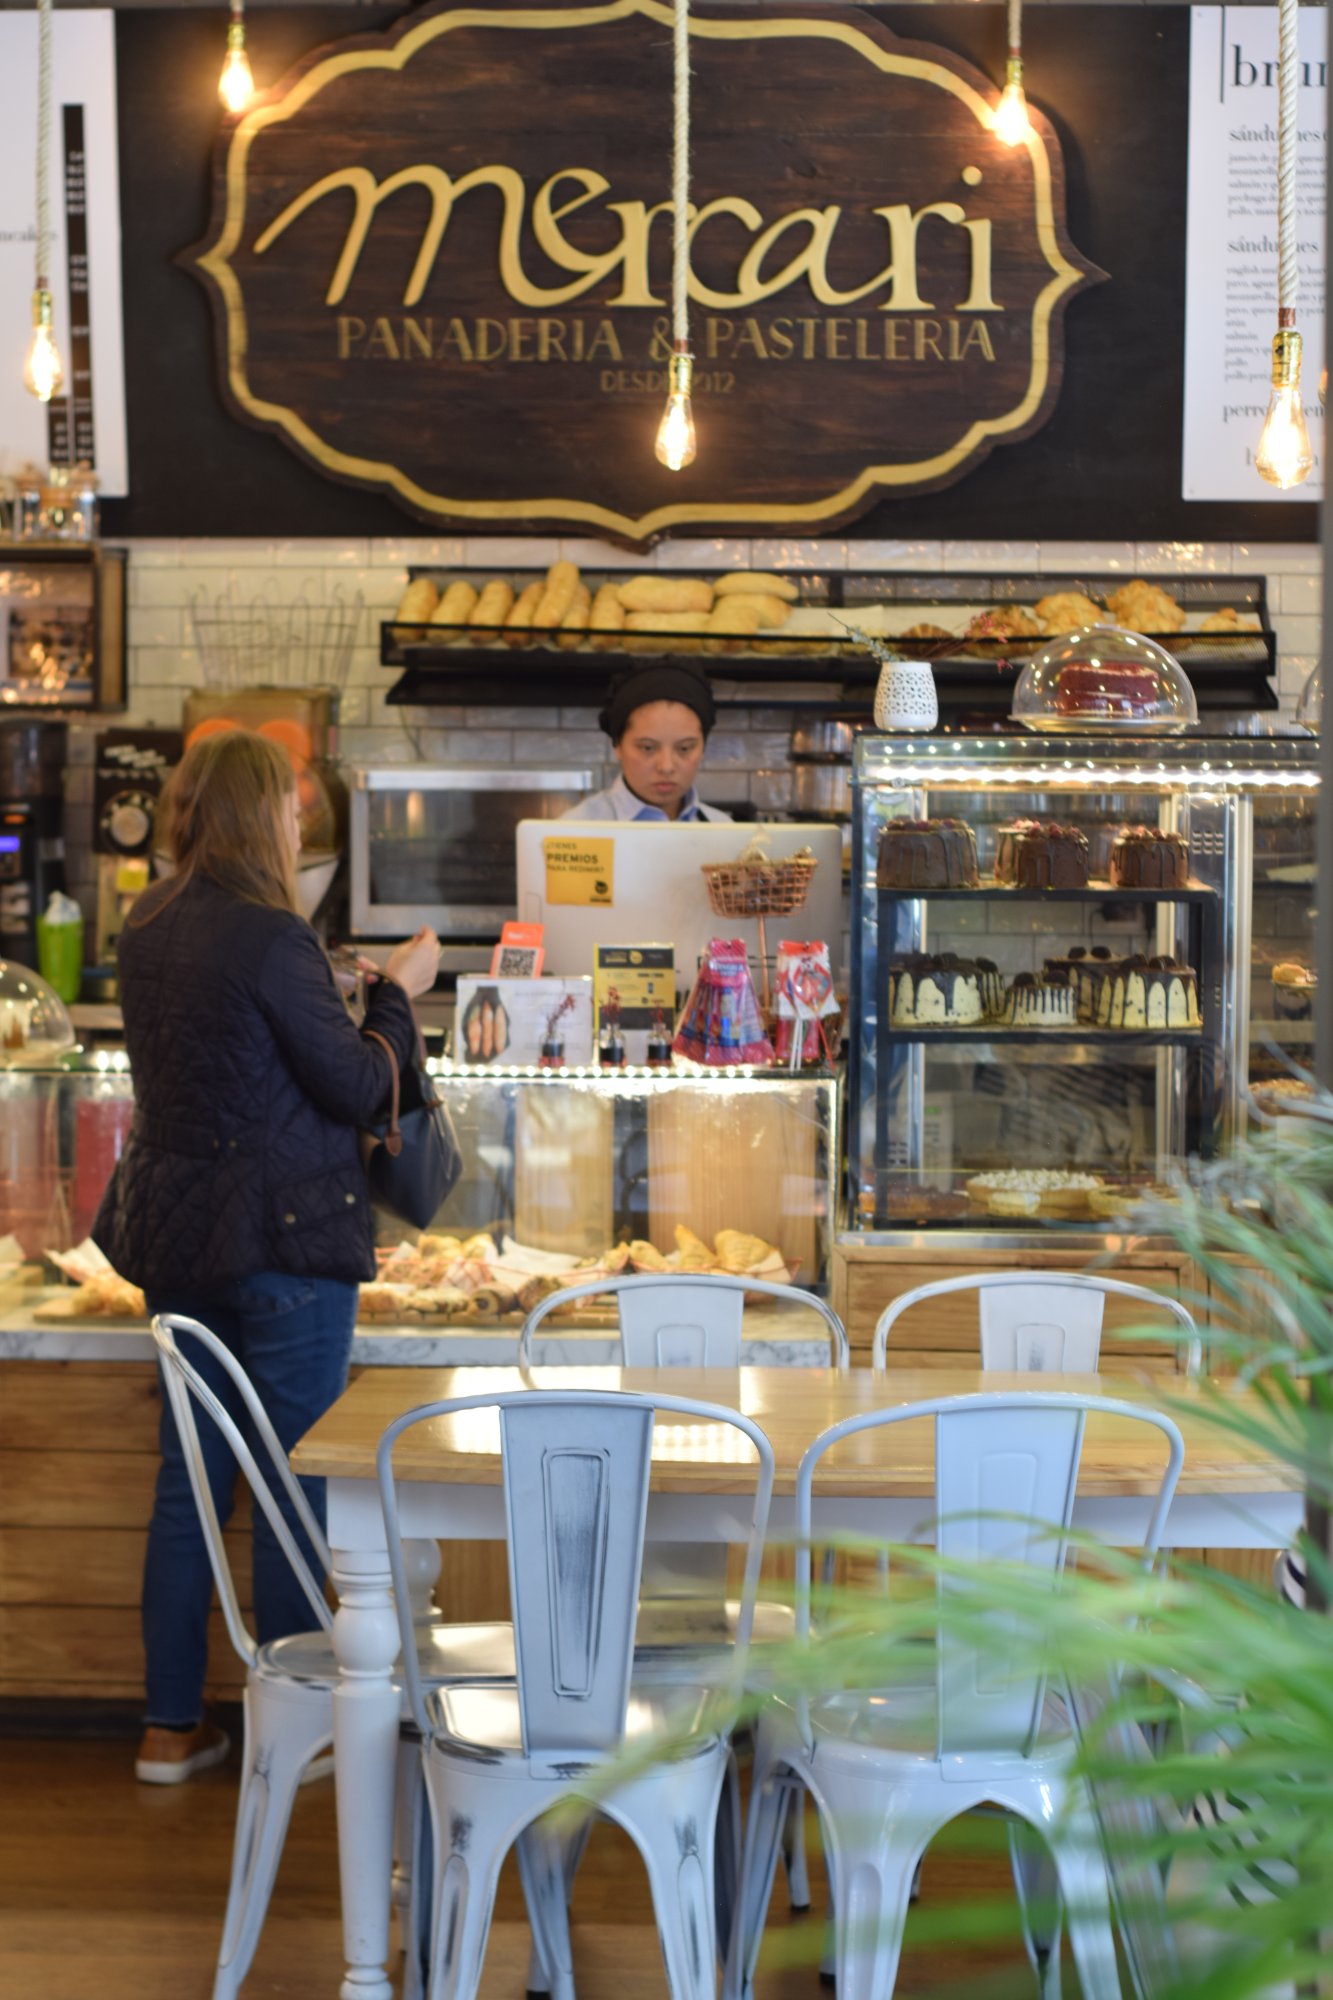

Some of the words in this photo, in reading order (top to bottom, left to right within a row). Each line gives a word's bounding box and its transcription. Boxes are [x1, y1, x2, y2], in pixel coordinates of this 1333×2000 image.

[253, 165, 1004, 311] mercari
[338, 316, 621, 362] PANADERIA
[649, 316, 677, 363] &
[706, 317, 996, 362] PASTELERIA
[546, 852, 598, 865] PREMIOS
